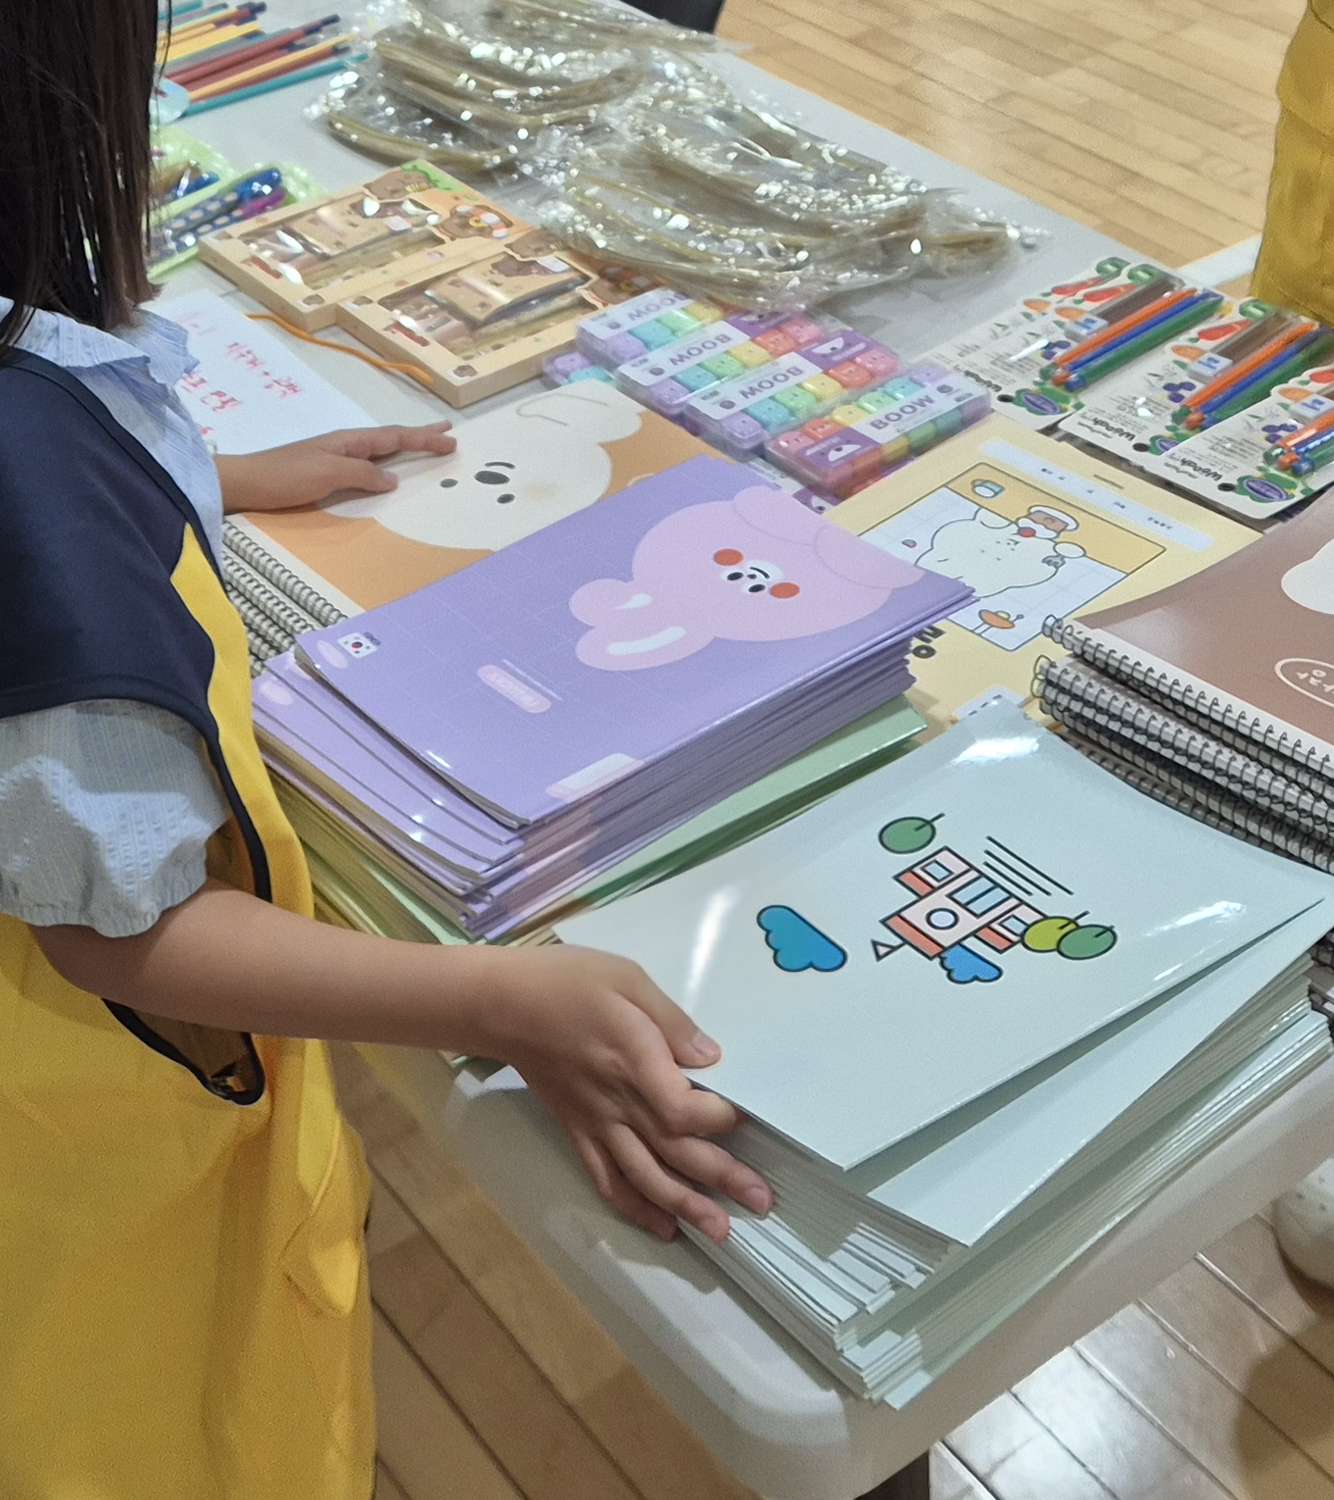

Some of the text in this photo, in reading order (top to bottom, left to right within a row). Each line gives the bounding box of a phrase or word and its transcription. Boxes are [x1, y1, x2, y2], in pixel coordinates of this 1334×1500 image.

[669, 333, 732, 366] BOOW
[739, 366, 804, 399] BOOW
[870, 394, 935, 430] BOOW
